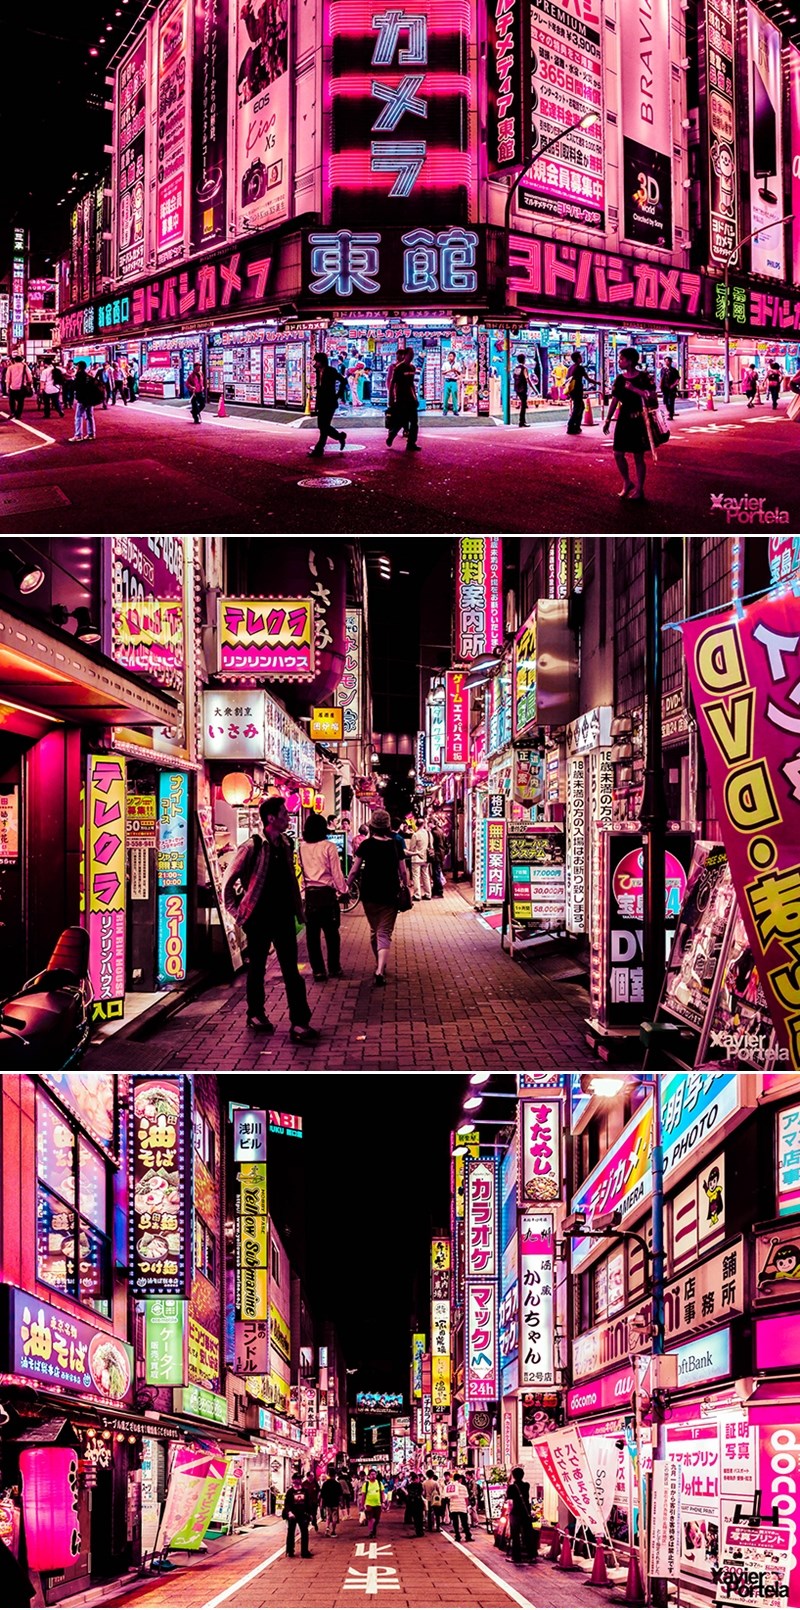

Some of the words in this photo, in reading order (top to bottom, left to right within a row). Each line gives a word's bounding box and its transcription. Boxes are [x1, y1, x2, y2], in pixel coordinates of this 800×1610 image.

[372, 11, 428, 198] カメラ
[308, 229, 477, 296] 東館
[460, 538, 486, 658] 無料案内所
[224, 608, 308, 636] テレクラ
[223, 655, 308, 668] リンリンハウス
[208, 723, 259, 740] いさみ
[491, 796, 502, 817] 格安
[93, 762, 122, 905] テレクラ
[488, 824, 503, 897] 無料案内所
[101, 915, 112, 999] リンリンハウス
[93, 1001, 122, 1021] 入口
[239, 1123, 262, 1135] 浅川
[240, 1139, 262, 1149] ビル
[471, 1178, 492, 1270] カラオケ
[523, 1268, 541, 1364] かんちゃん
[469, 1383, 494, 1396] 24h
[725, 1423, 749, 1439] 証明
[725, 1443, 749, 1459] 写真
